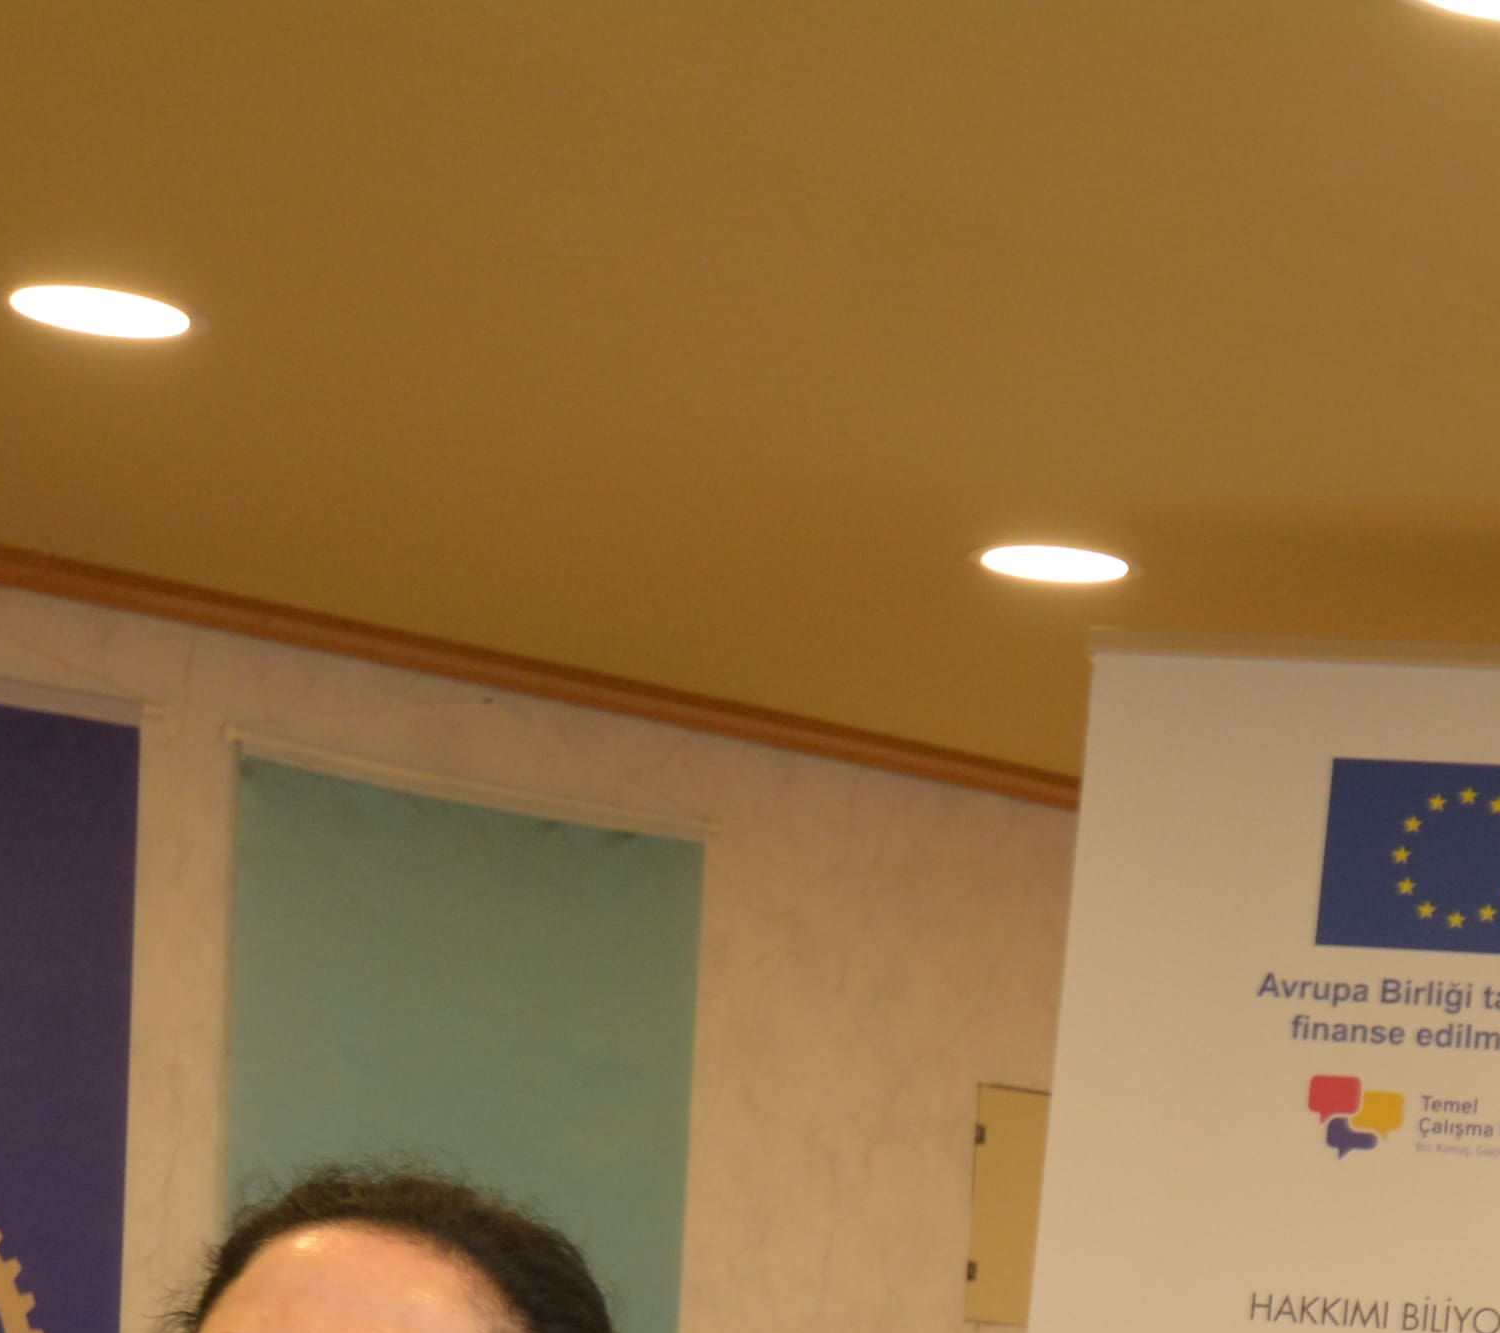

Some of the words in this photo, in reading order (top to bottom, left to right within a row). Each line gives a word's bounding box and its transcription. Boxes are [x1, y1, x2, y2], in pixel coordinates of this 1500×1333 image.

[1257, 972, 1369, 1008] Avrupa
[1380, 978, 1474, 1014] Birliği
[1290, 1014, 1406, 1046] finanse
[1421, 1095, 1479, 1114] Temel
[1418, 1116, 1495, 1140] Çalışma
[1249, 1293, 1389, 1330] HAKKIMI
